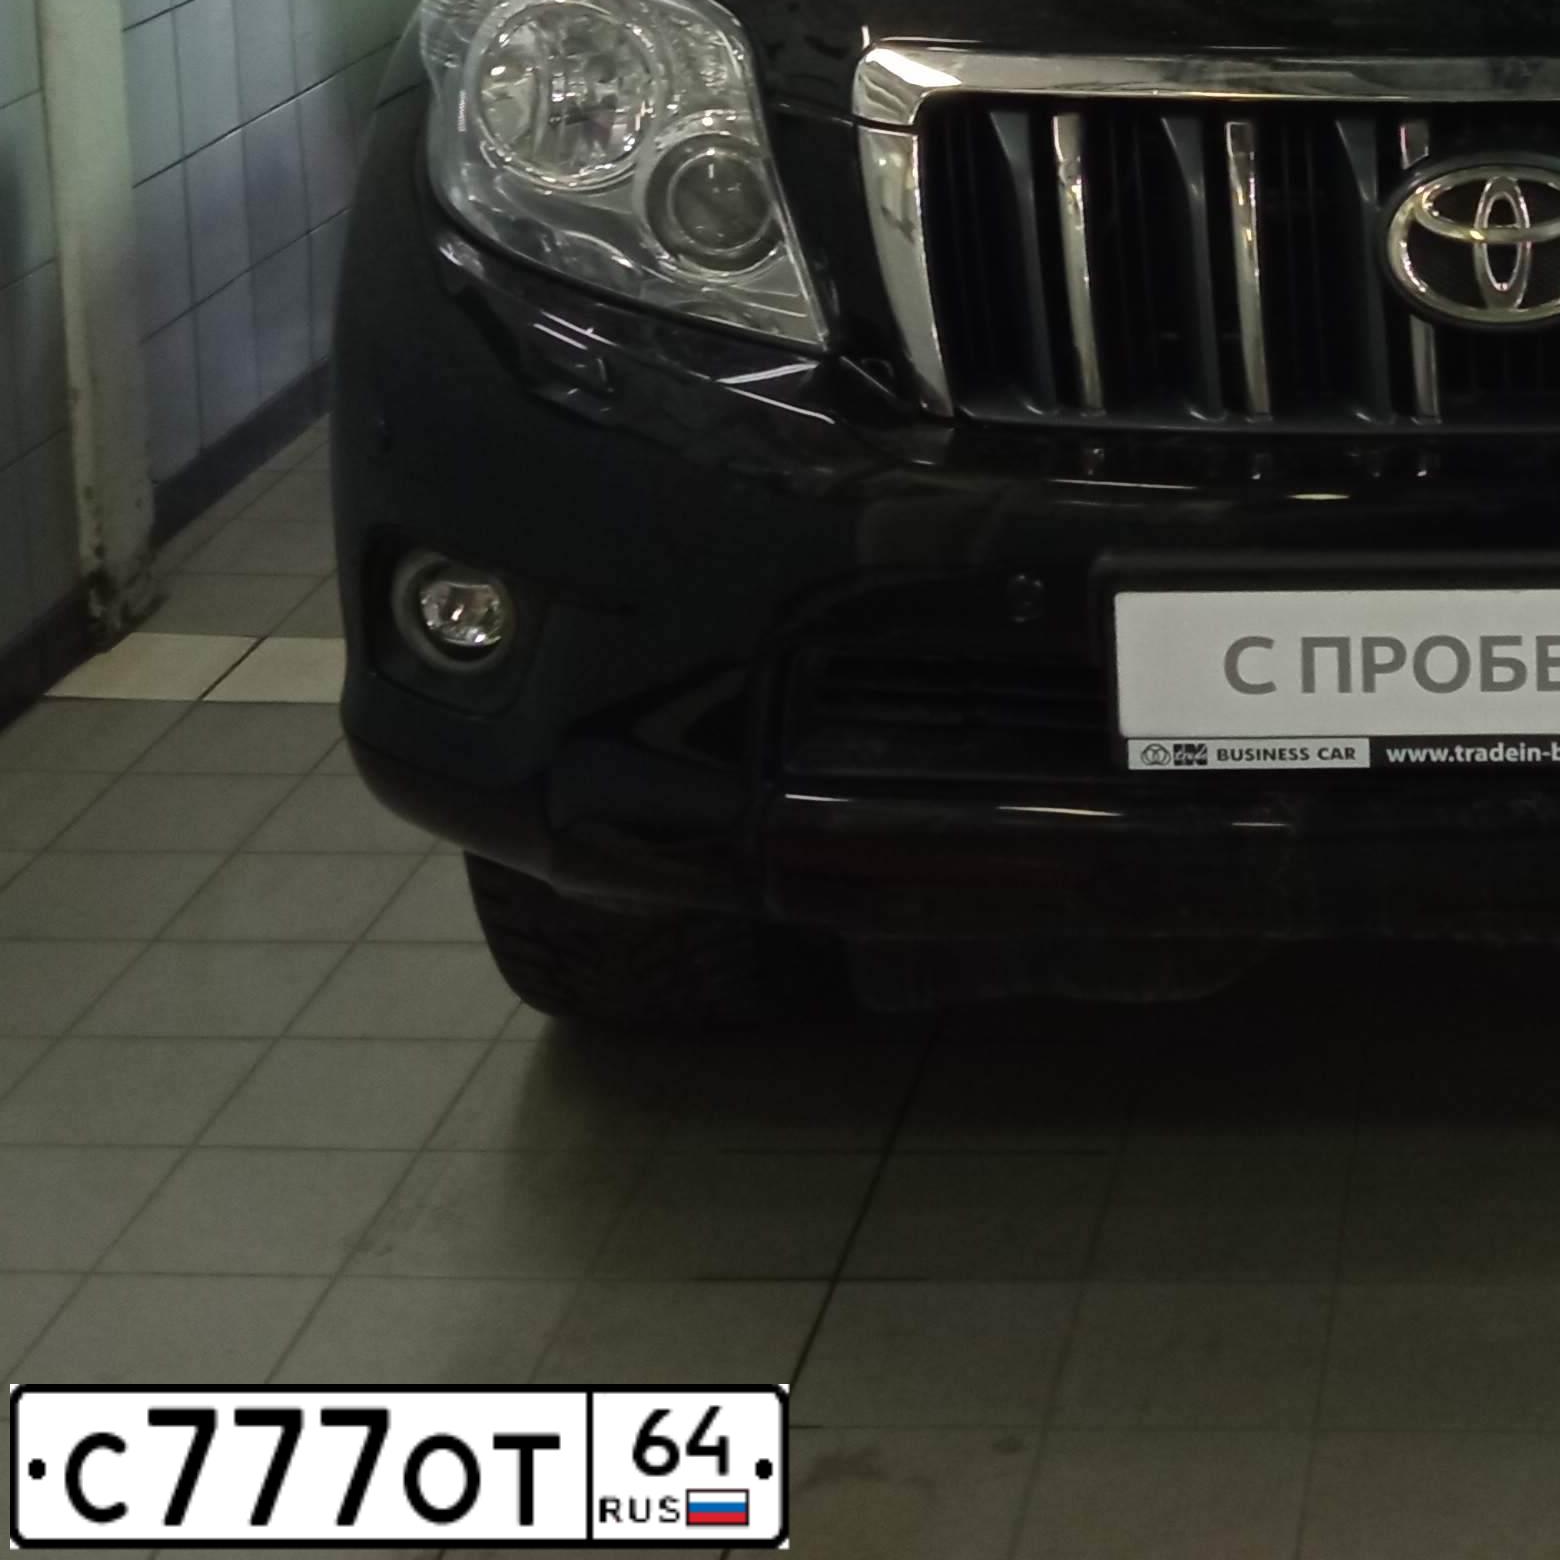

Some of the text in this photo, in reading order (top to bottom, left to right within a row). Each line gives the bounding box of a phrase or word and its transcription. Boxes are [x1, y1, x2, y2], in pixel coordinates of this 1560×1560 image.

[1223, 636, 1276, 695] С
[1216, 747, 1311, 762] BUSINESS
[1317, 746, 1356, 761] CAR
